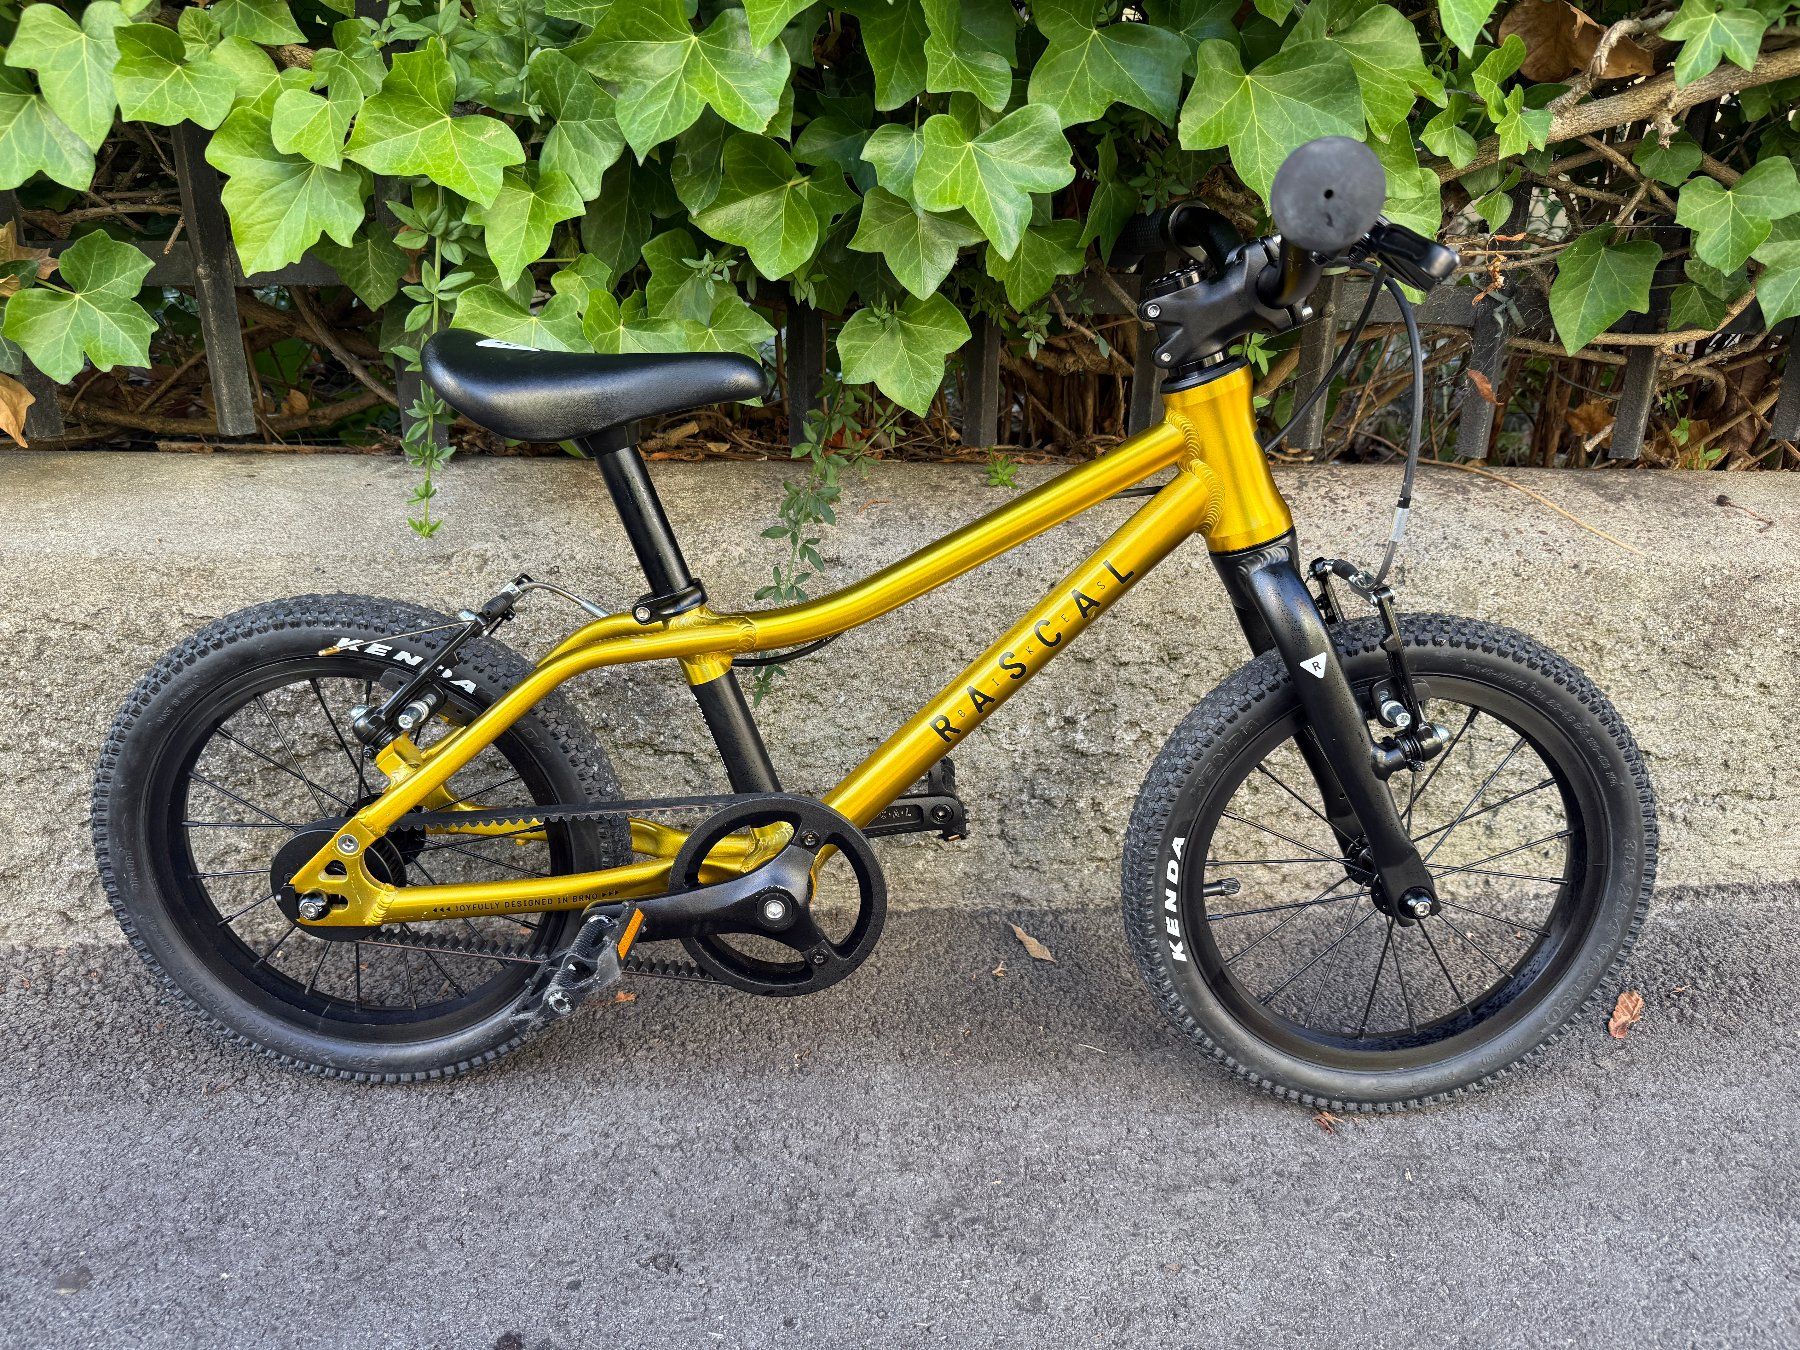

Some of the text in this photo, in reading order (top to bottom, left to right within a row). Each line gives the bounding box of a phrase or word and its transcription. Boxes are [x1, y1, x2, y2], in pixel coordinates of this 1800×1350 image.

[929, 559, 1135, 743] RASCAL
[957, 580, 1106, 718] BIKES
[1311, 661, 1322, 671] R
[455, 893, 598, 913] JOYFULLY DESIGNED IN BRNO
[1164, 837, 1188, 962] KENDA
